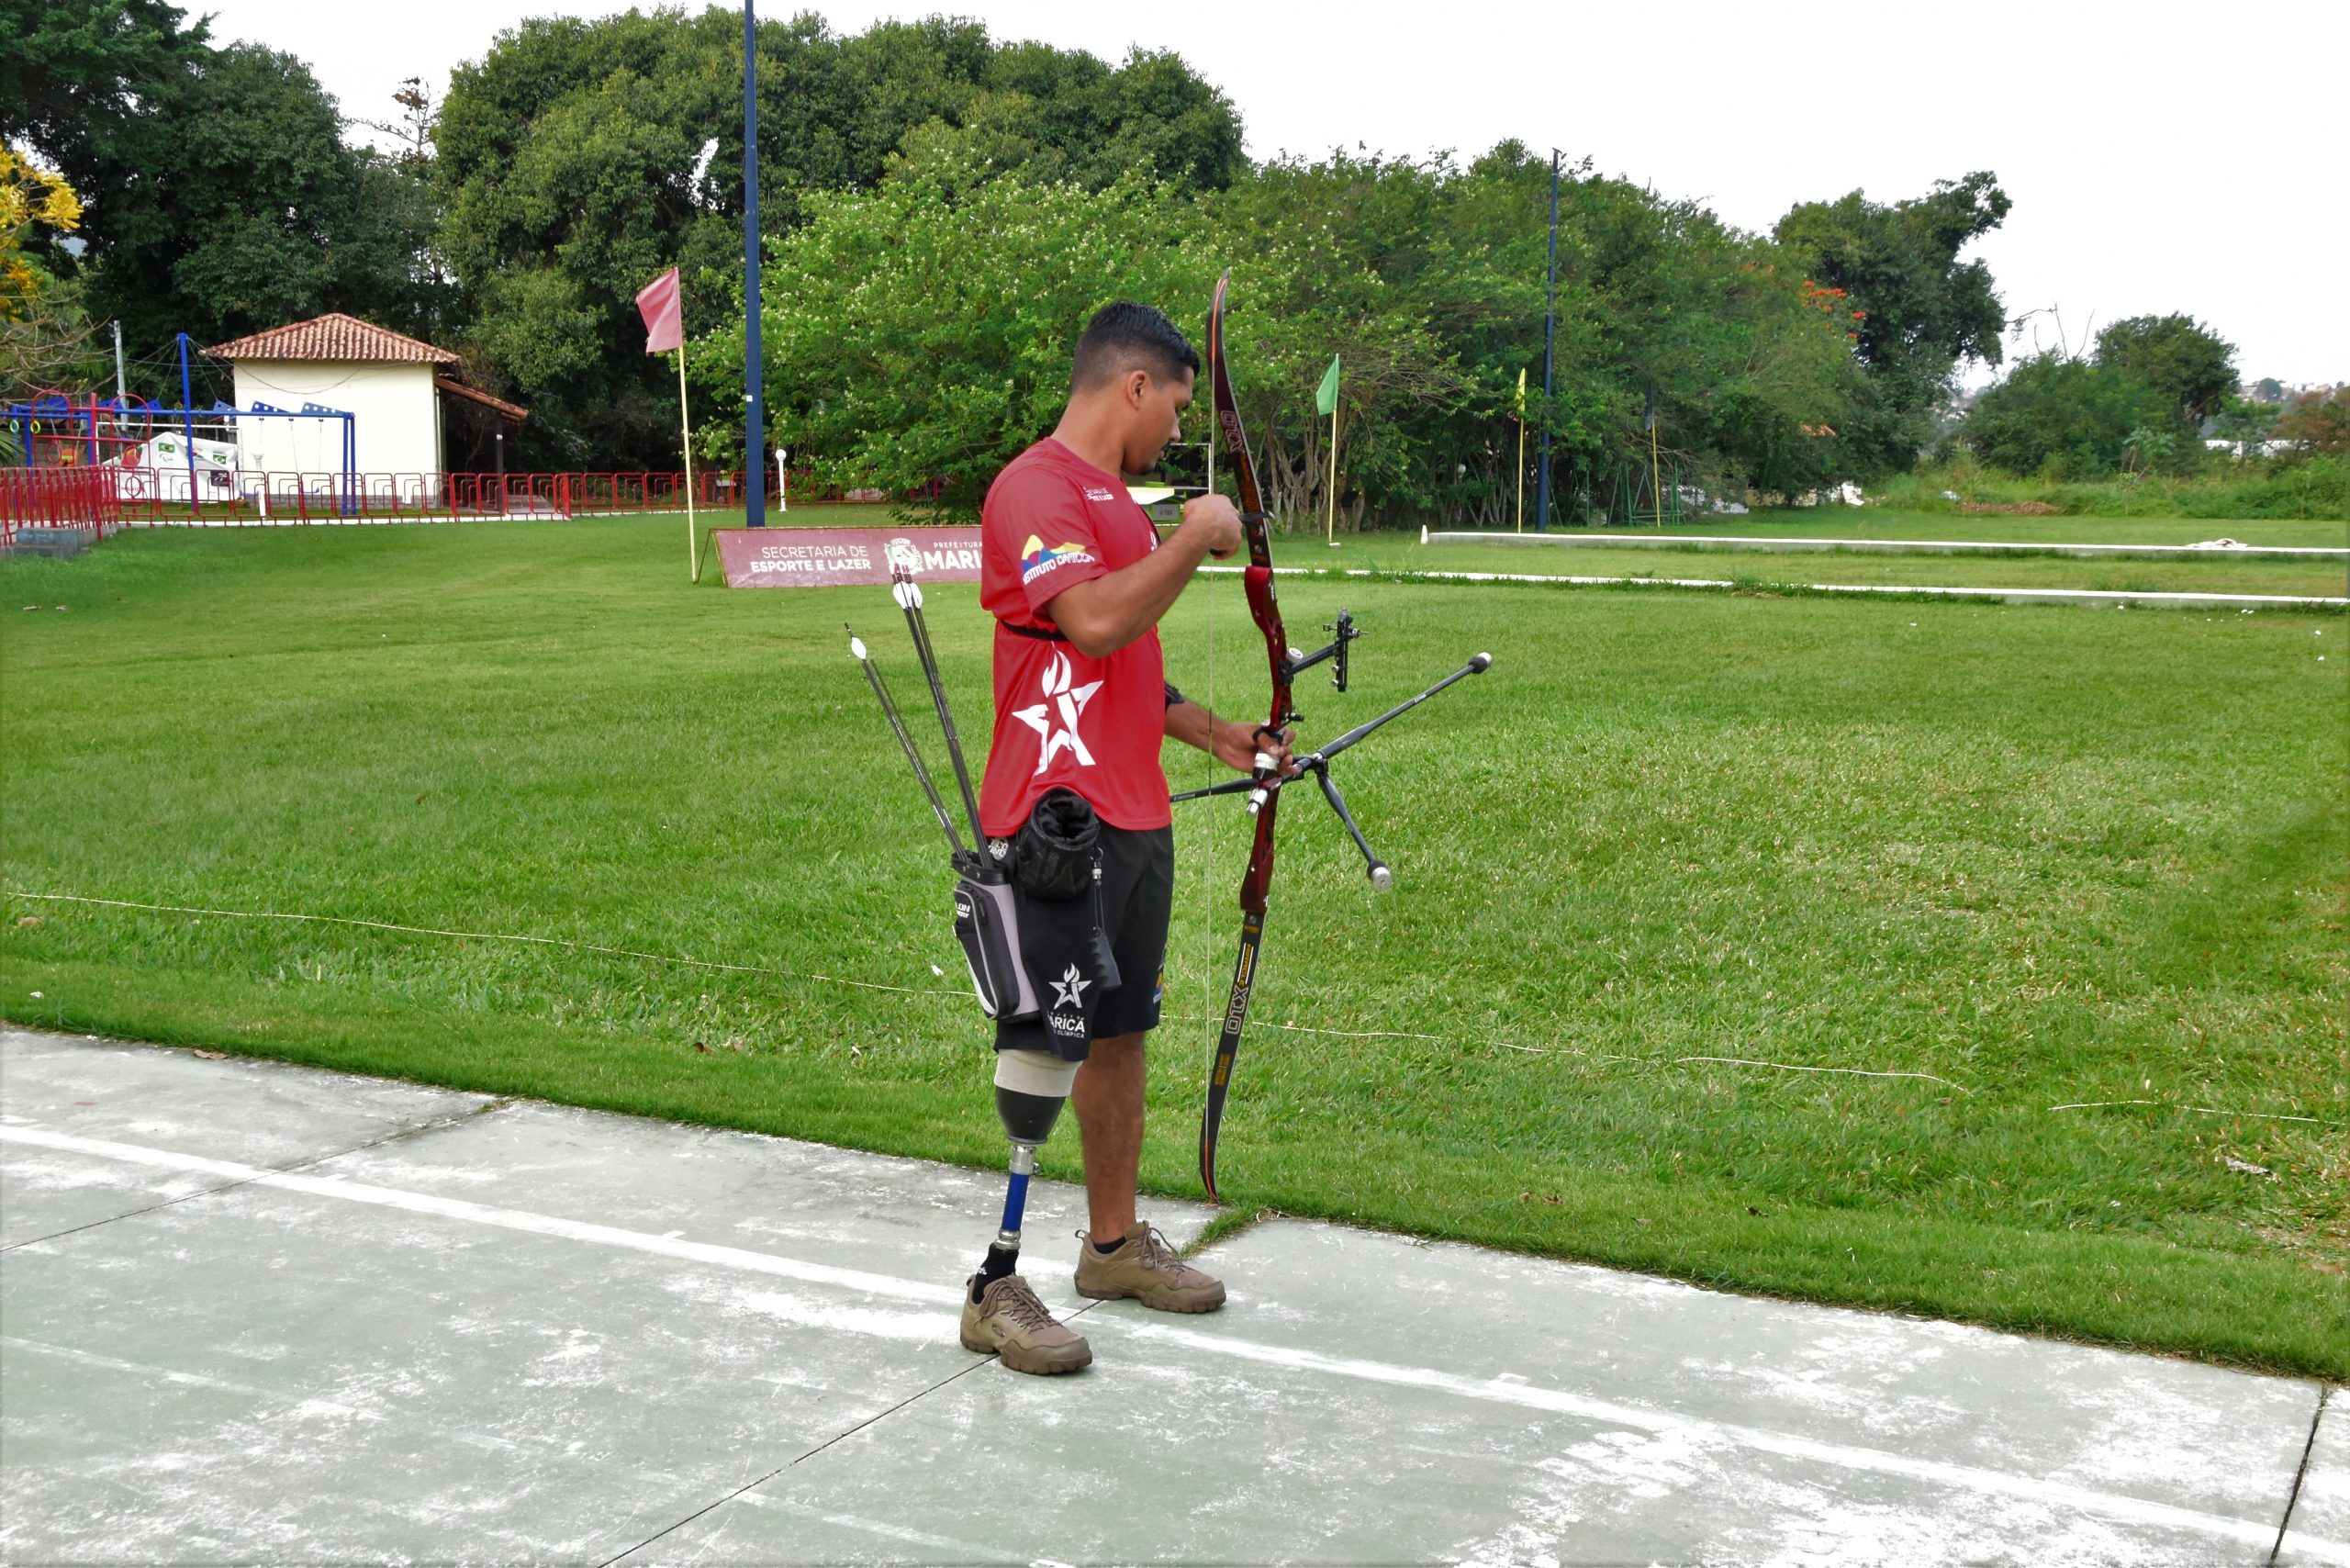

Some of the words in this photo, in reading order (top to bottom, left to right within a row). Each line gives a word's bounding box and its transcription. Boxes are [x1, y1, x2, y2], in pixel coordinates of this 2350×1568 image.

[762, 546, 847, 558] SECRETARIA
[849, 545, 868, 557] DE
[923, 550, 982, 570] MARI
[750, 560, 813, 573] ESPORTE
[815, 560, 825, 570] E
[828, 559, 871, 570] LAZER
[1225, 985, 1248, 1035] X10
[1047, 1014, 1085, 1033] ARICÁ
